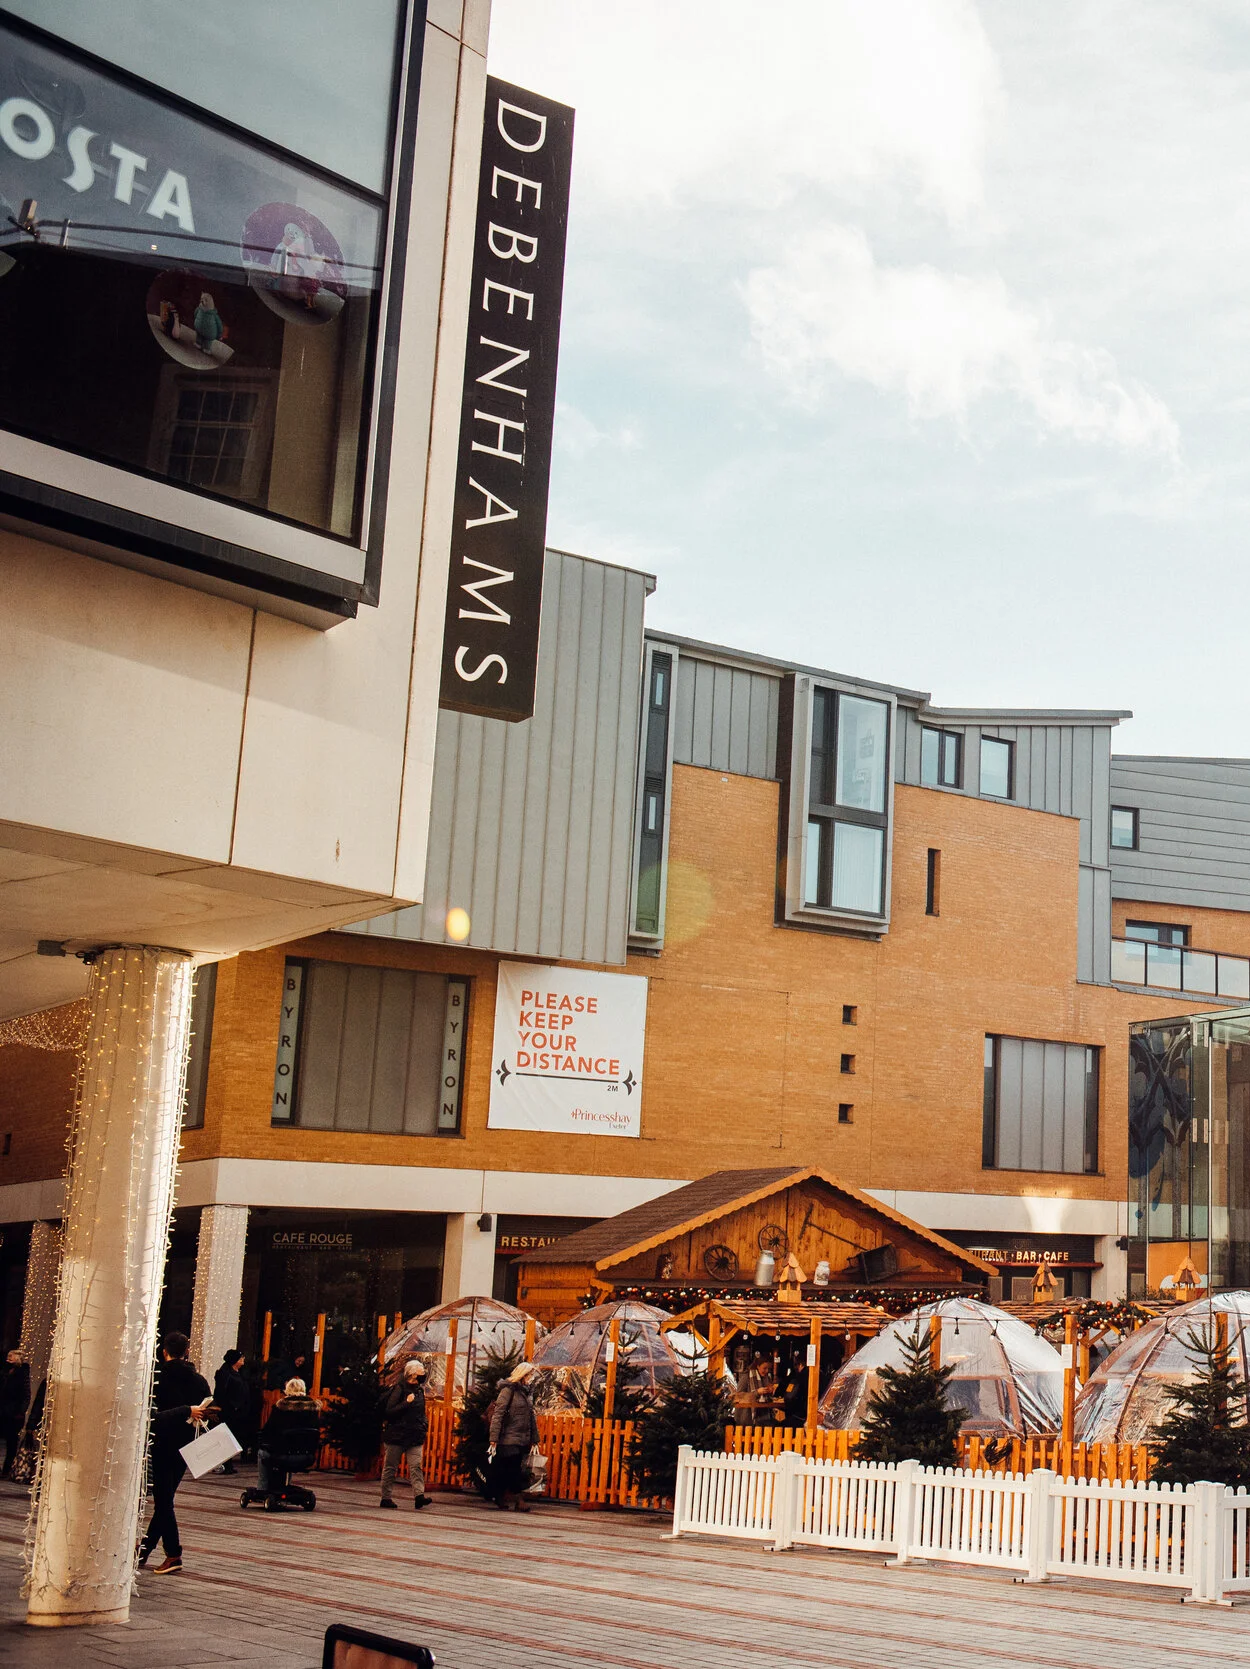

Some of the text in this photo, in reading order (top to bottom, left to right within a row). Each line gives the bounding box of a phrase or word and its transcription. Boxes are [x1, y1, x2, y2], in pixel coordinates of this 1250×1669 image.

[0, 97, 196, 234] OSTA
[454, 98, 547, 685] DEBENHAMS
[521, 990, 598, 1014] PLEASE
[519, 1010, 574, 1031] KEEP
[275, 979, 297, 1105] BYRON
[518, 1030, 577, 1052] YOUR
[443, 995, 461, 1116] BYRON
[516, 1051, 620, 1076] DISTANCE
[573, 1108, 632, 1123] Princesshay
[309, 1233, 353, 1244] ROUGE
[1016, 1251, 1037, 1261] BAR
[1043, 1251, 1069, 1261] CAFE
